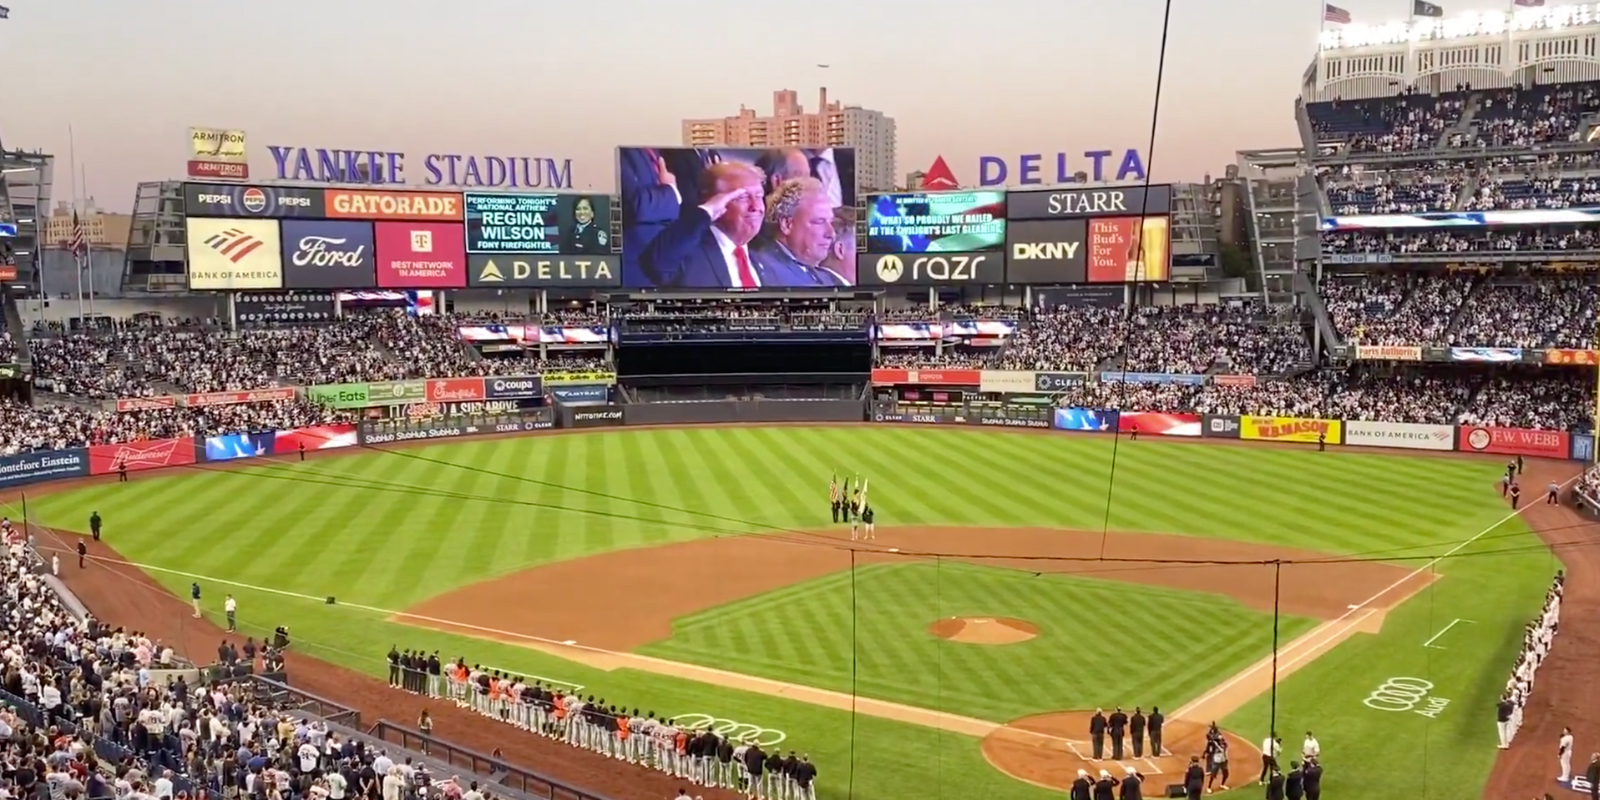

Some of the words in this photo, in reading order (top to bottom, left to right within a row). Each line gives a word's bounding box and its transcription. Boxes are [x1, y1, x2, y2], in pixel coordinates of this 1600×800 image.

[193, 131, 244, 143] ARMITRON
[197, 163, 243, 172] ARMITRON
[266, 146, 405, 184] YANKEE
[425, 154, 573, 189] STADIUM
[980, 149, 1146, 187] DELTA
[198, 194, 231, 204] PEPSI
[278, 196, 311, 206] PEPSI
[333, 194, 457, 215] GATORADE
[468, 197, 516, 205] PERFORMING
[518, 197, 557, 206] TONIGHT'S
[1047, 191, 1126, 214] STARR
[482, 212, 545, 226] REGINA
[880, 215, 905, 225] WHAT
[906, 215, 915, 224] SO
[916, 214, 950, 225] PROUDLY
[951, 214, 964, 223] WE
[965, 213, 992, 223] HAILED
[481, 226, 545, 240] WILSON
[869, 227, 878, 235] AT
[880, 227, 895, 235] THE
[942, 225, 961, 234] LAST
[1092, 221, 1118, 233] This
[477, 241, 499, 249] FDNY
[500, 241, 551, 249] FIREFIGHTER
[1092, 233, 1124, 245] Bud's
[292, 235, 365, 268] Ford
[1013, 241, 1079, 260] DKNY
[1092, 245, 1112, 256] For
[391, 260, 411, 269] BEST
[412, 260, 454, 270] NETWORK
[1092, 256, 1117, 267] You.
[399, 268, 408, 277] IN
[409, 269, 447, 278] AMERICA
[513, 260, 613, 280] DELTA
[912, 256, 986, 280] razr
[191, 271, 217, 280] BANK
[221, 271, 232, 280] OF
[235, 271, 279, 280] AMERICA
[1380, 347, 1418, 356] Authority
[506, 381, 533, 391] coupa
[1055, 378, 1084, 387] CLEAR
[339, 391, 366, 402] Eats
[450, 403, 457, 414] A
[365, 433, 394, 444] StubHub
[396, 430, 427, 441] StubHub
[428, 427, 460, 438] StubHub
[1347, 430, 1372, 438] BANK
[1374, 431, 1387, 439] OF
[1388, 432, 1430, 440] AMERICA
[1492, 430, 1516, 443] F.W.
[1520, 433, 1560, 446] WEBB
[118, 448, 170, 462] Budweiser
[0, 460, 40, 474] ontefiore
[41, 454, 80, 467] Einstein
[1413, 696, 1451, 719] Audi
